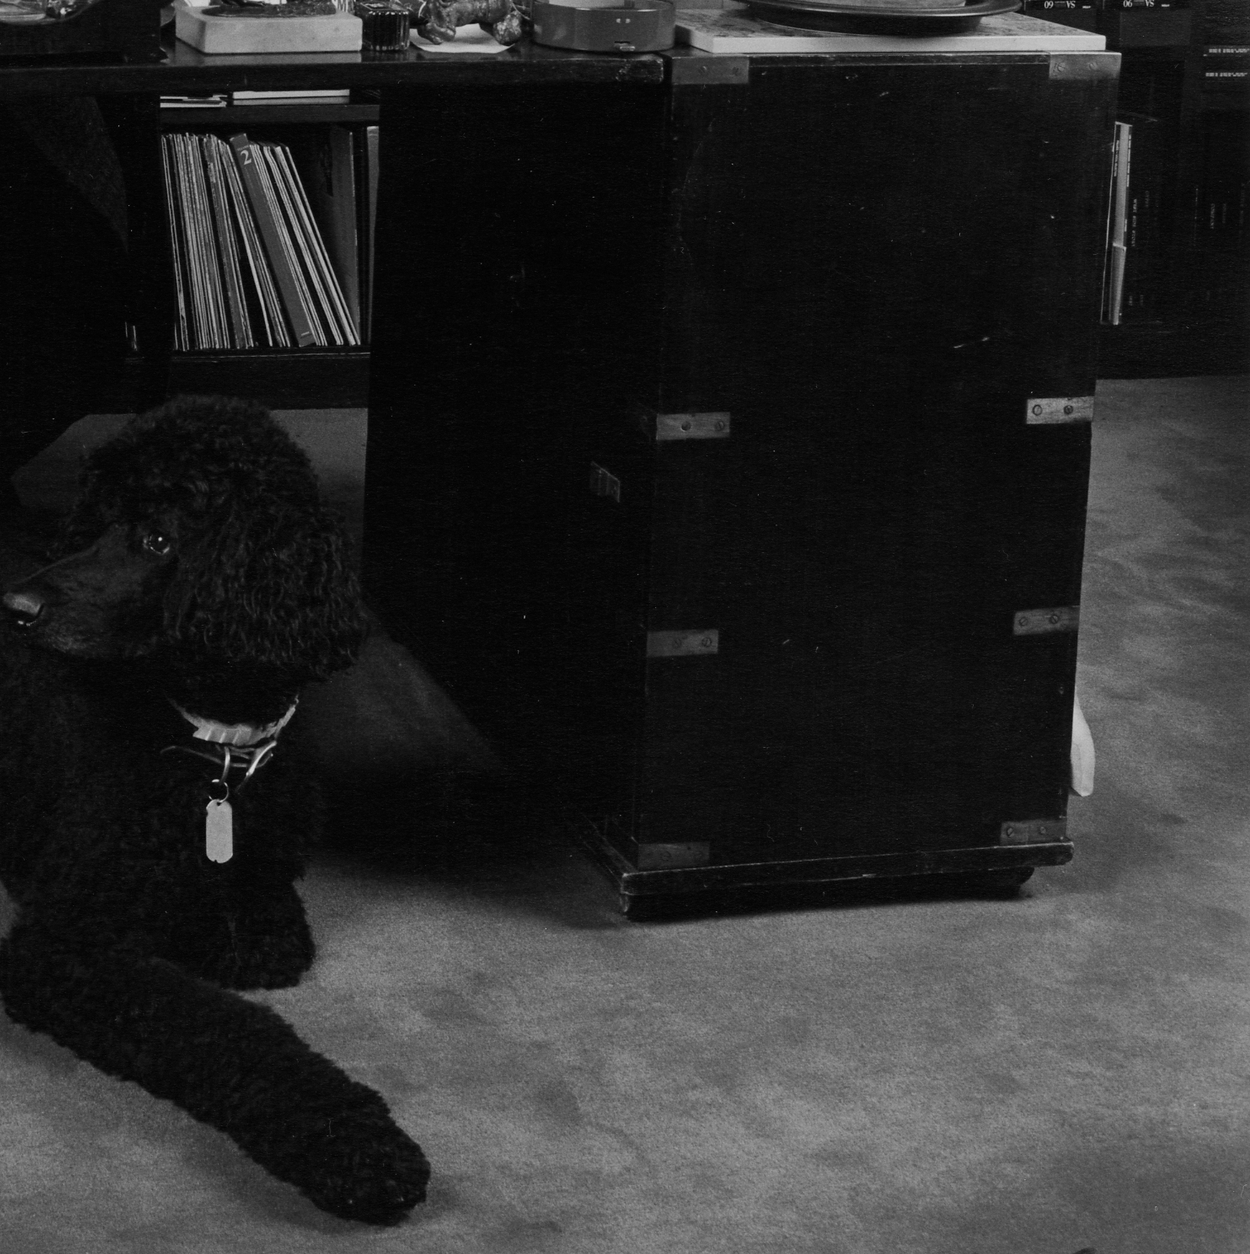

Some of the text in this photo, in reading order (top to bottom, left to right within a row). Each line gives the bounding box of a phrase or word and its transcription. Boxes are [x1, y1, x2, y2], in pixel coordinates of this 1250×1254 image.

[1043, 0, 1076, 9] SA 60
[1122, 0, 1155, 8] SA 90
[239, 149, 252, 165] 2
